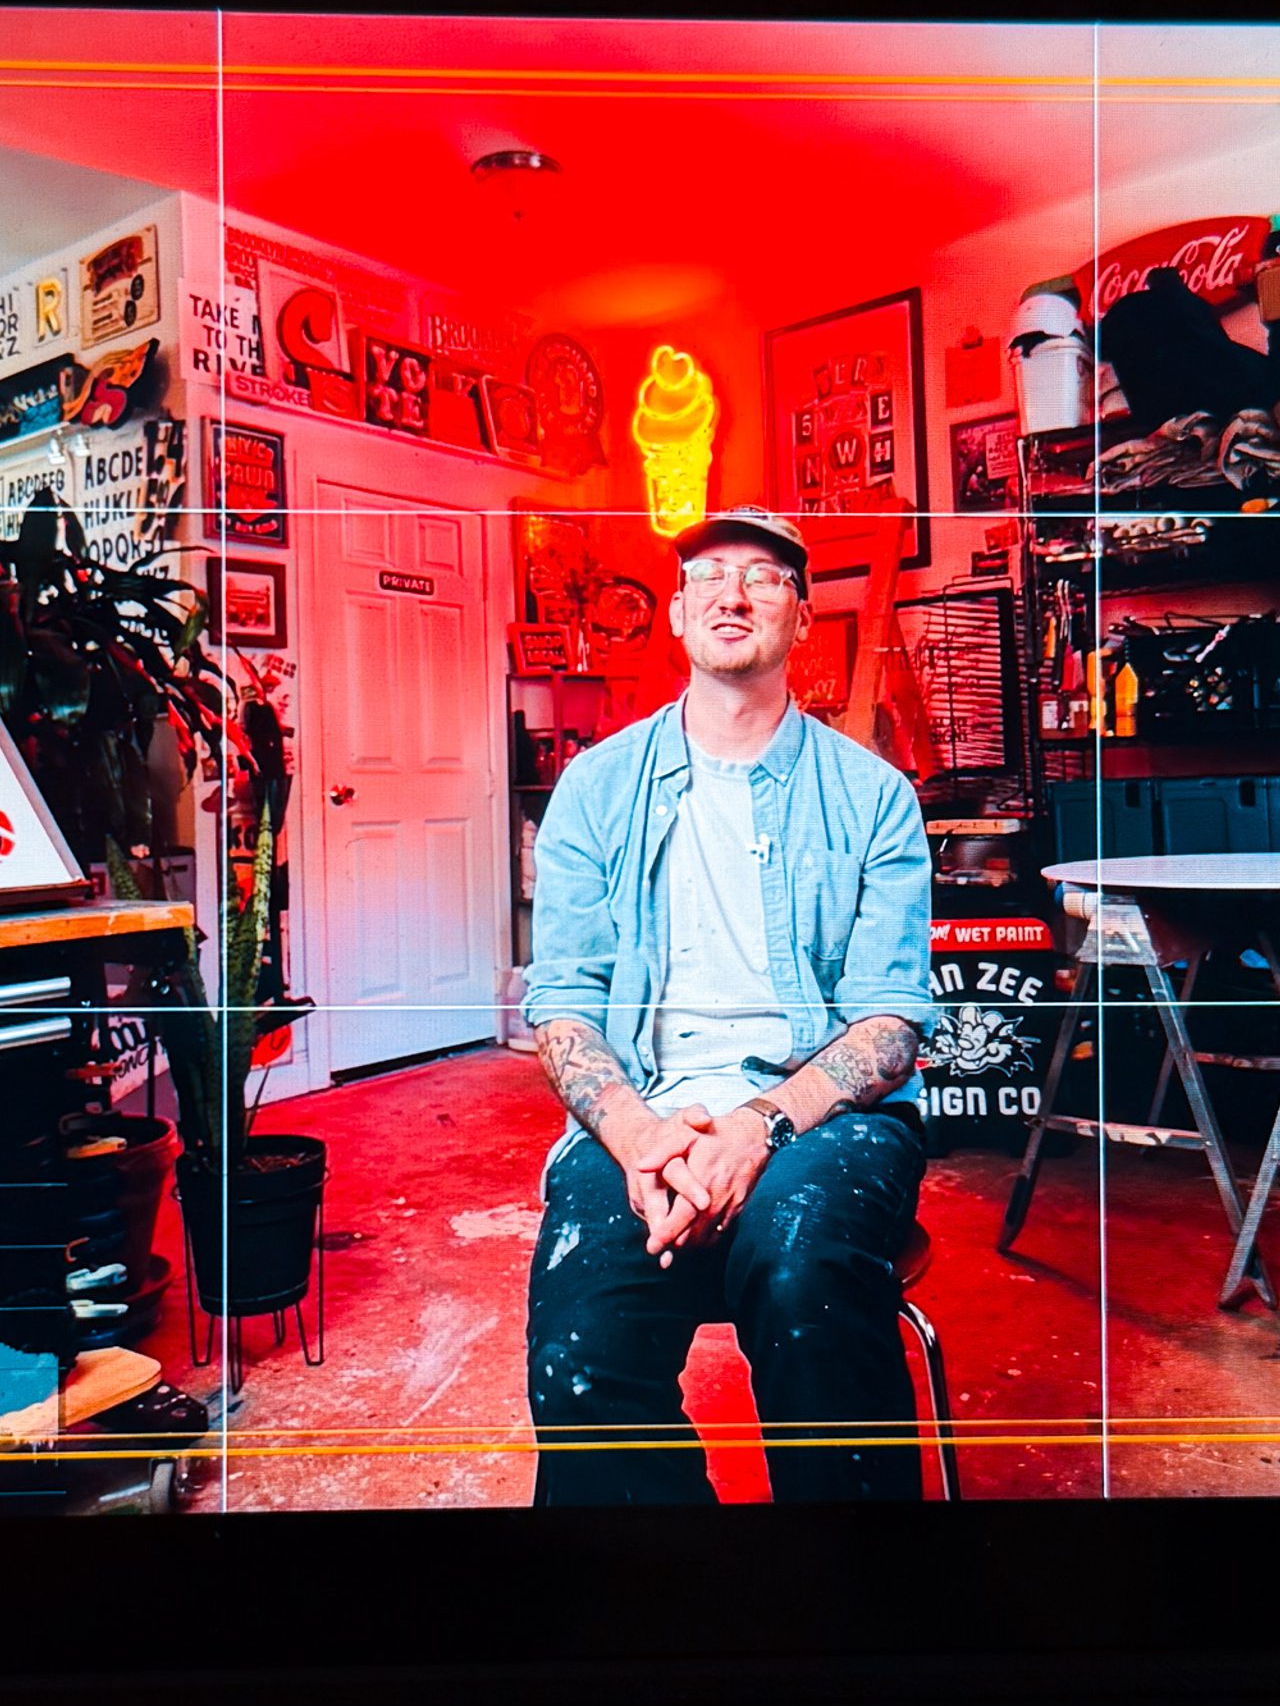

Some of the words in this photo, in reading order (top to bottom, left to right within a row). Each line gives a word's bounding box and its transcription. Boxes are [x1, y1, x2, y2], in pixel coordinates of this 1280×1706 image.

[190, 293, 240, 330] TAKE
[202, 324, 227, 350] TO
[236, 334, 262, 361] TH
[193, 348, 267, 378] RIVE
[382, 573, 433, 593] PRIVATE
[955, 926, 992, 943] WET
[996, 925, 1044, 943] PAINT
[998, 1086, 1041, 1117] CO
